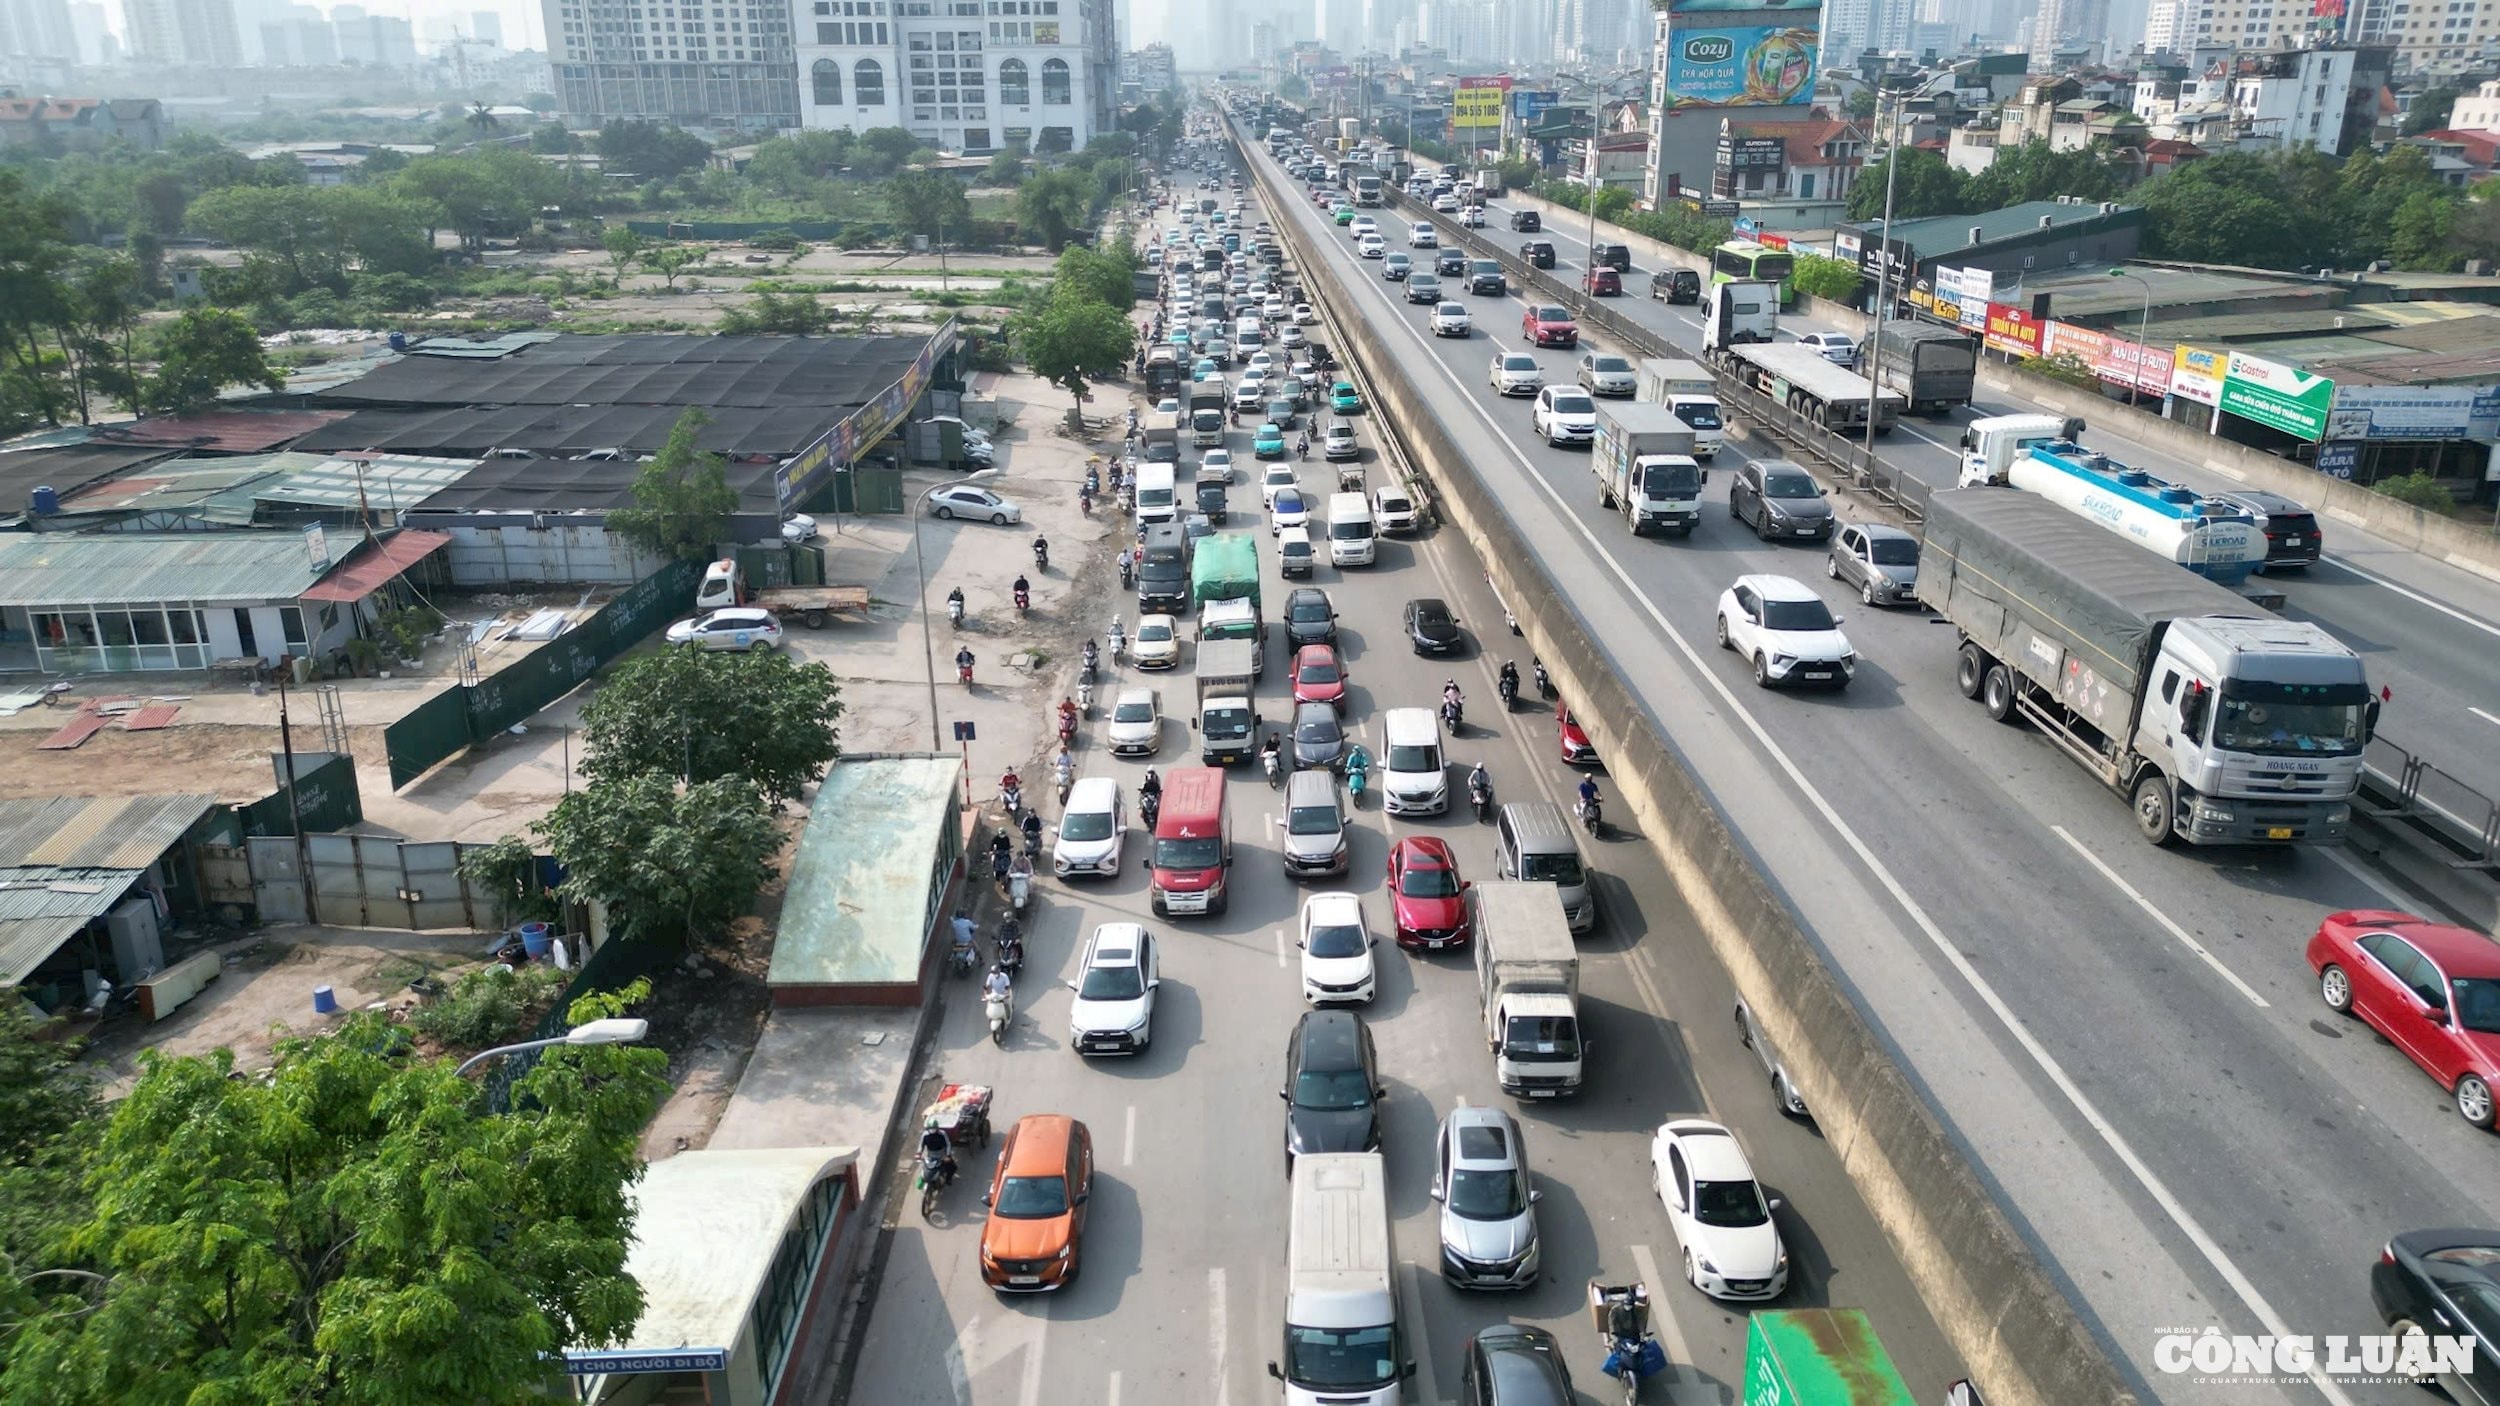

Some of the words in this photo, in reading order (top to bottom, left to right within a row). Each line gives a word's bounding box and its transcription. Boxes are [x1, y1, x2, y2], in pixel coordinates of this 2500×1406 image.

[1688, 41, 1729, 58] Cozy
[1469, 104, 1482, 117] 55
[2111, 345, 2126, 360] HUY
[2147, 354, 2169, 372] AUTO
[2186, 351, 2215, 368] MPE
[2240, 362, 2270, 379] Castrol
[2319, 455, 2355, 467] GARA
[584, 1361, 616, 1371] CHO
[621, 1356, 671, 1370] NGƯỜI
[674, 1357, 690, 1368] ĐI
[695, 1355, 718, 1369] BỘ
